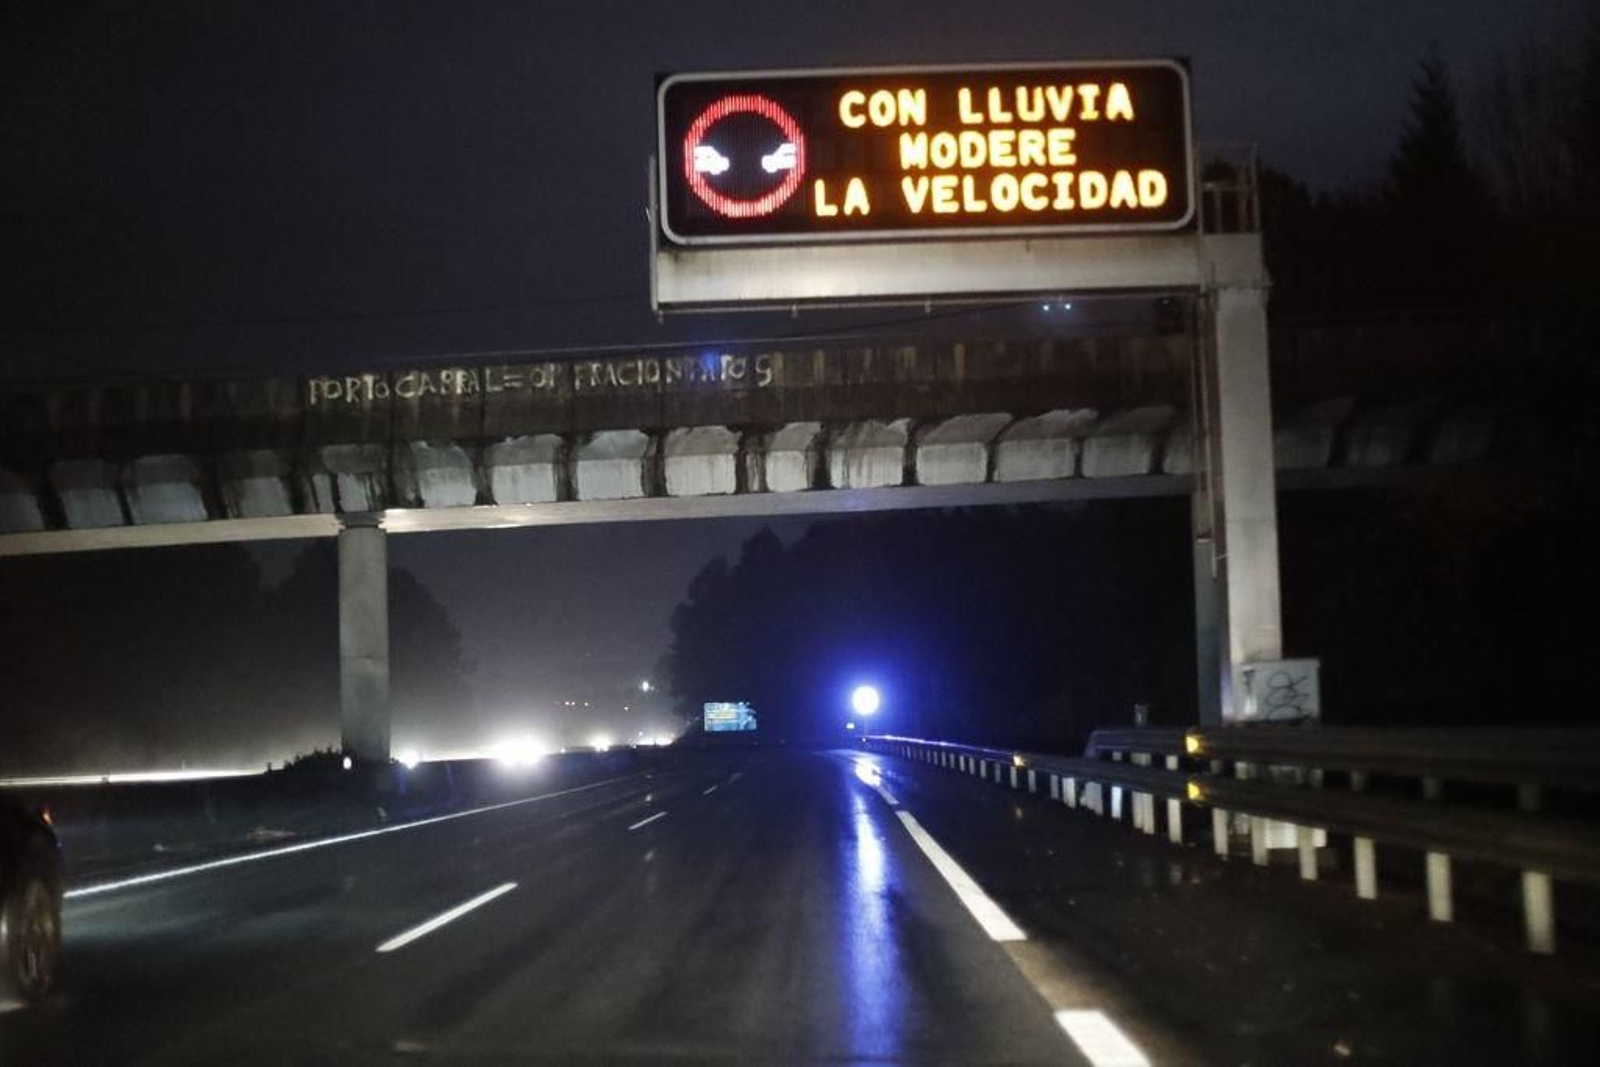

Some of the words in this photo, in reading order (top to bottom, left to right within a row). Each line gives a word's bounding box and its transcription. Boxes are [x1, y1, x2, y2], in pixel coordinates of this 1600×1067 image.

[838, 88, 927, 129] CON
[957, 83, 1135, 124] LLUVIA
[899, 128, 1076, 171] MODERE
[813, 177, 871, 217] LA
[900, 170, 1168, 214] VELOCIDAD
